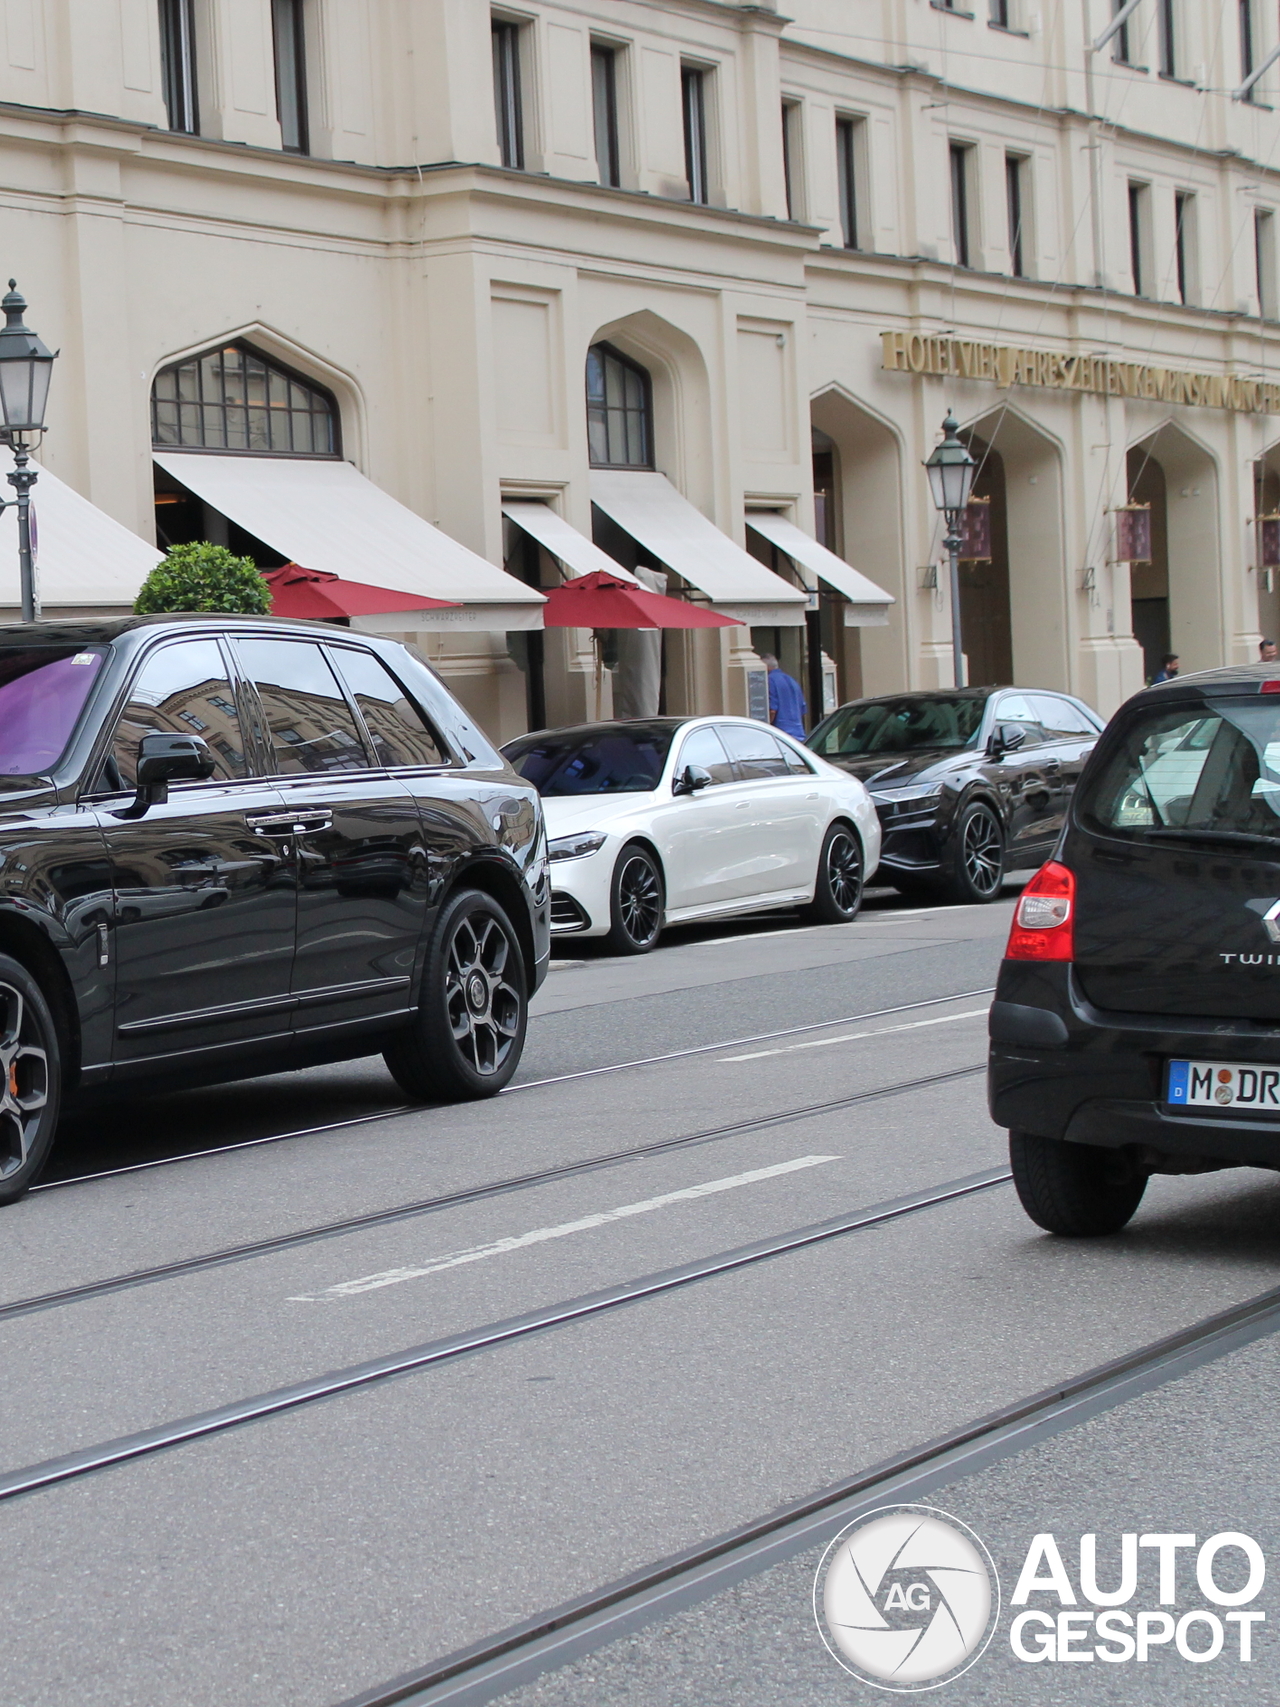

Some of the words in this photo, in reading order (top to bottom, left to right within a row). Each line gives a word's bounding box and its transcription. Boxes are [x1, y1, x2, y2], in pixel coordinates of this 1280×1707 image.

[881, 331, 960, 375] HOTEL
[959, 340, 1001, 381] VIER
[421, 611, 477, 622] SCHWARZREITER
[1219, 953, 1280, 966] TWI
[1174, 1087, 1183, 1097] D
[1191, 1067, 1212, 1100] M
[1236, 1069, 1279, 1104] DR
